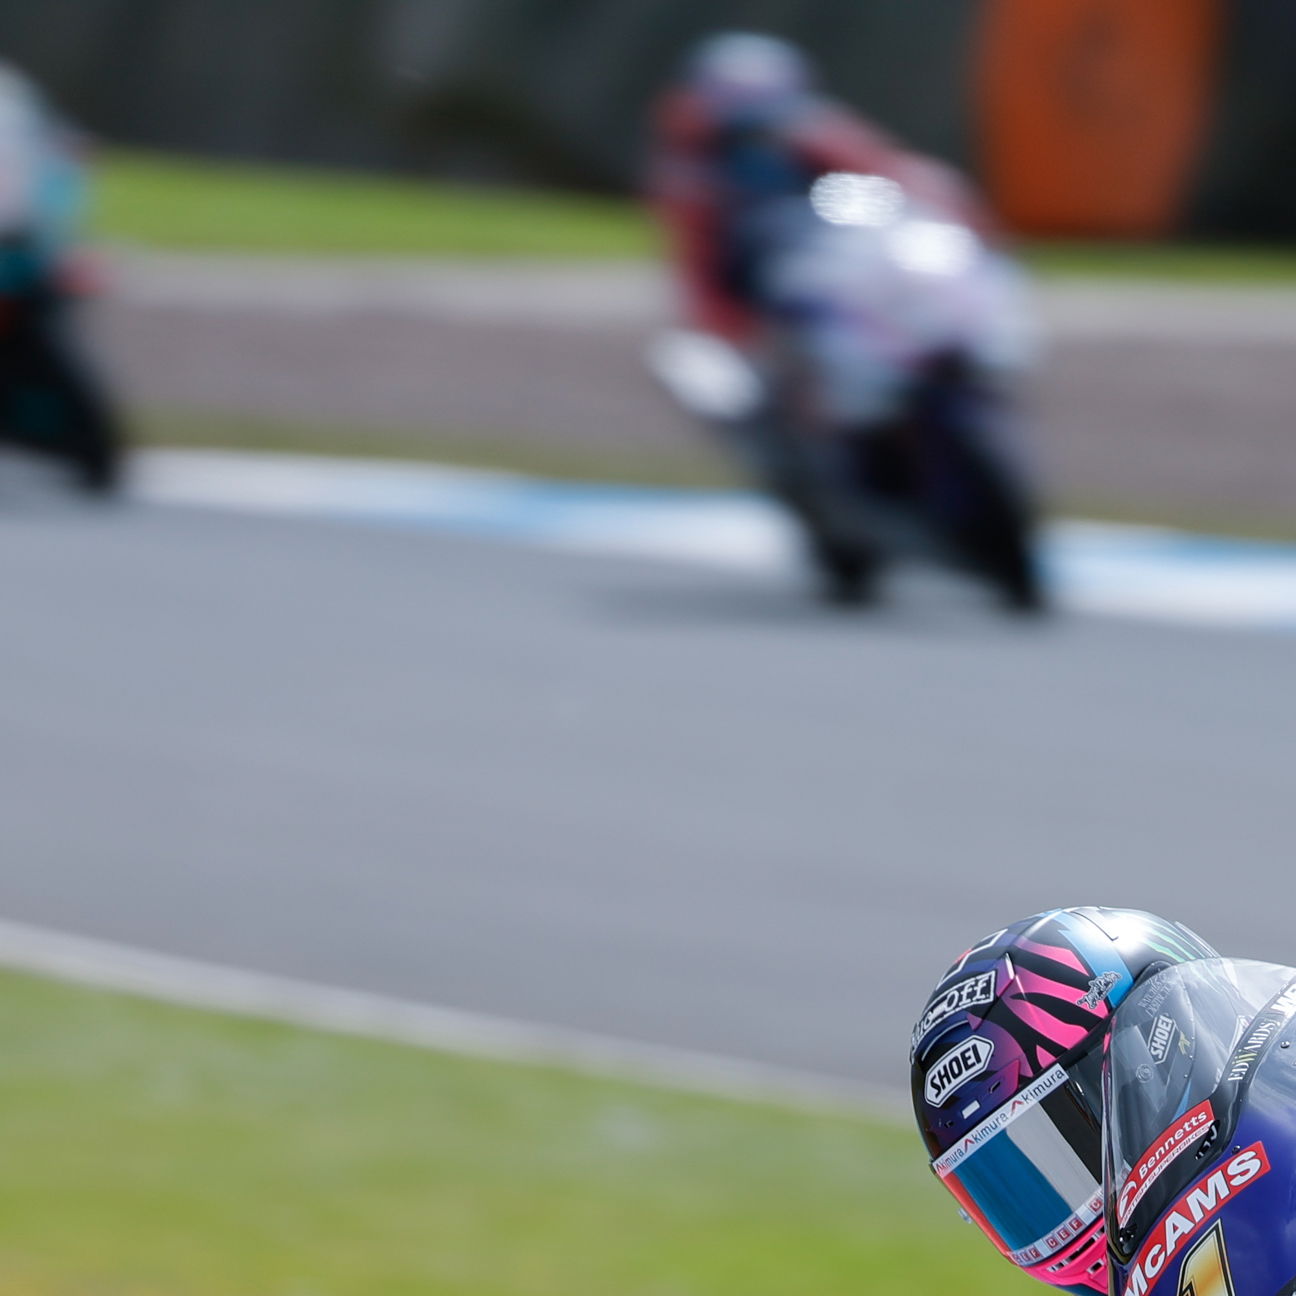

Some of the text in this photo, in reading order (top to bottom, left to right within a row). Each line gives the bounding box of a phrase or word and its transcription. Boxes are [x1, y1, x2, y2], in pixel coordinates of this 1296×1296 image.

[1150, 1013, 1173, 1060] SHOEI
[929, 1043, 983, 1099] SHOEI
[965, 1112, 1008, 1153] Akimura
[1010, 1069, 1065, 1116] Akimura
[1138, 1111, 1207, 1179] Bennetts
